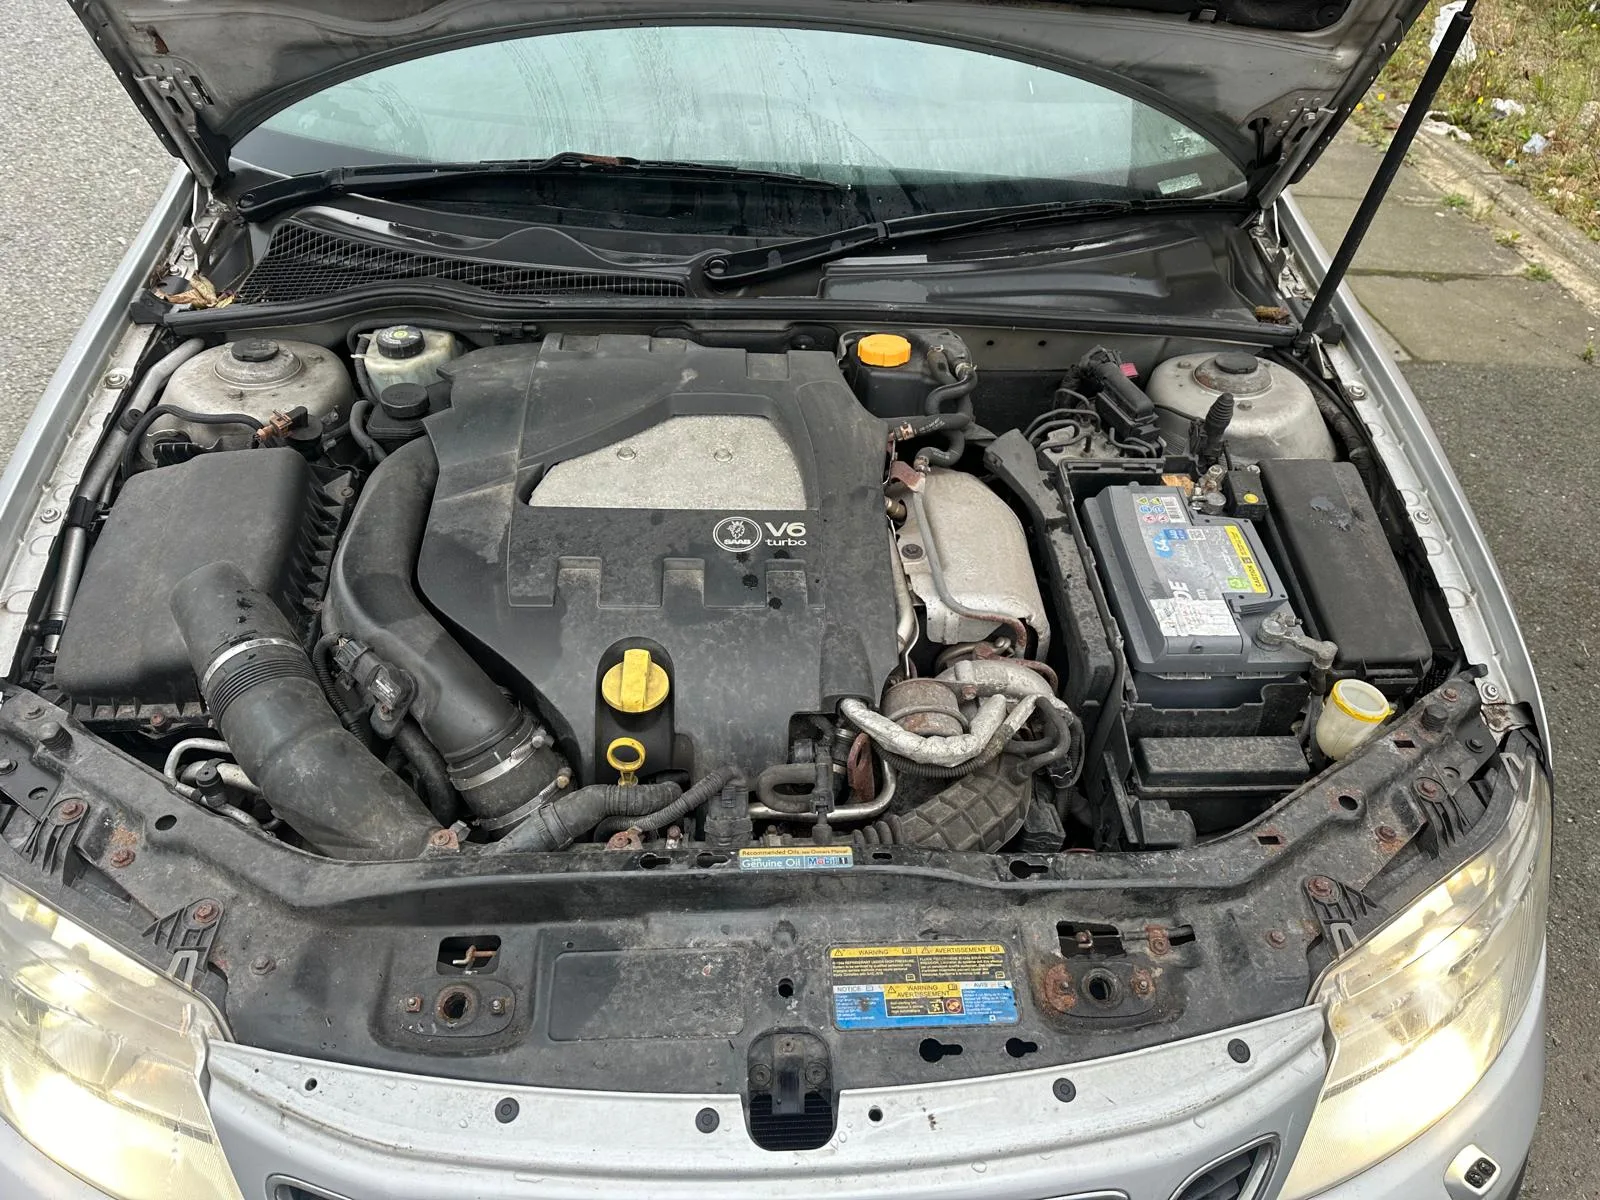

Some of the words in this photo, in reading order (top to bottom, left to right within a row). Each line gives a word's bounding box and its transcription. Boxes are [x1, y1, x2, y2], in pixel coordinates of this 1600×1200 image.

[764, 522, 806, 537] V6
[765, 538, 807, 546] turbo
[1154, 539, 1170, 552] 64
[1247, 565, 1261, 587] CAUTION
[742, 859, 783, 868] Genuine
[785, 858, 800, 867] Oil
[808, 857, 837, 865] Mobil
